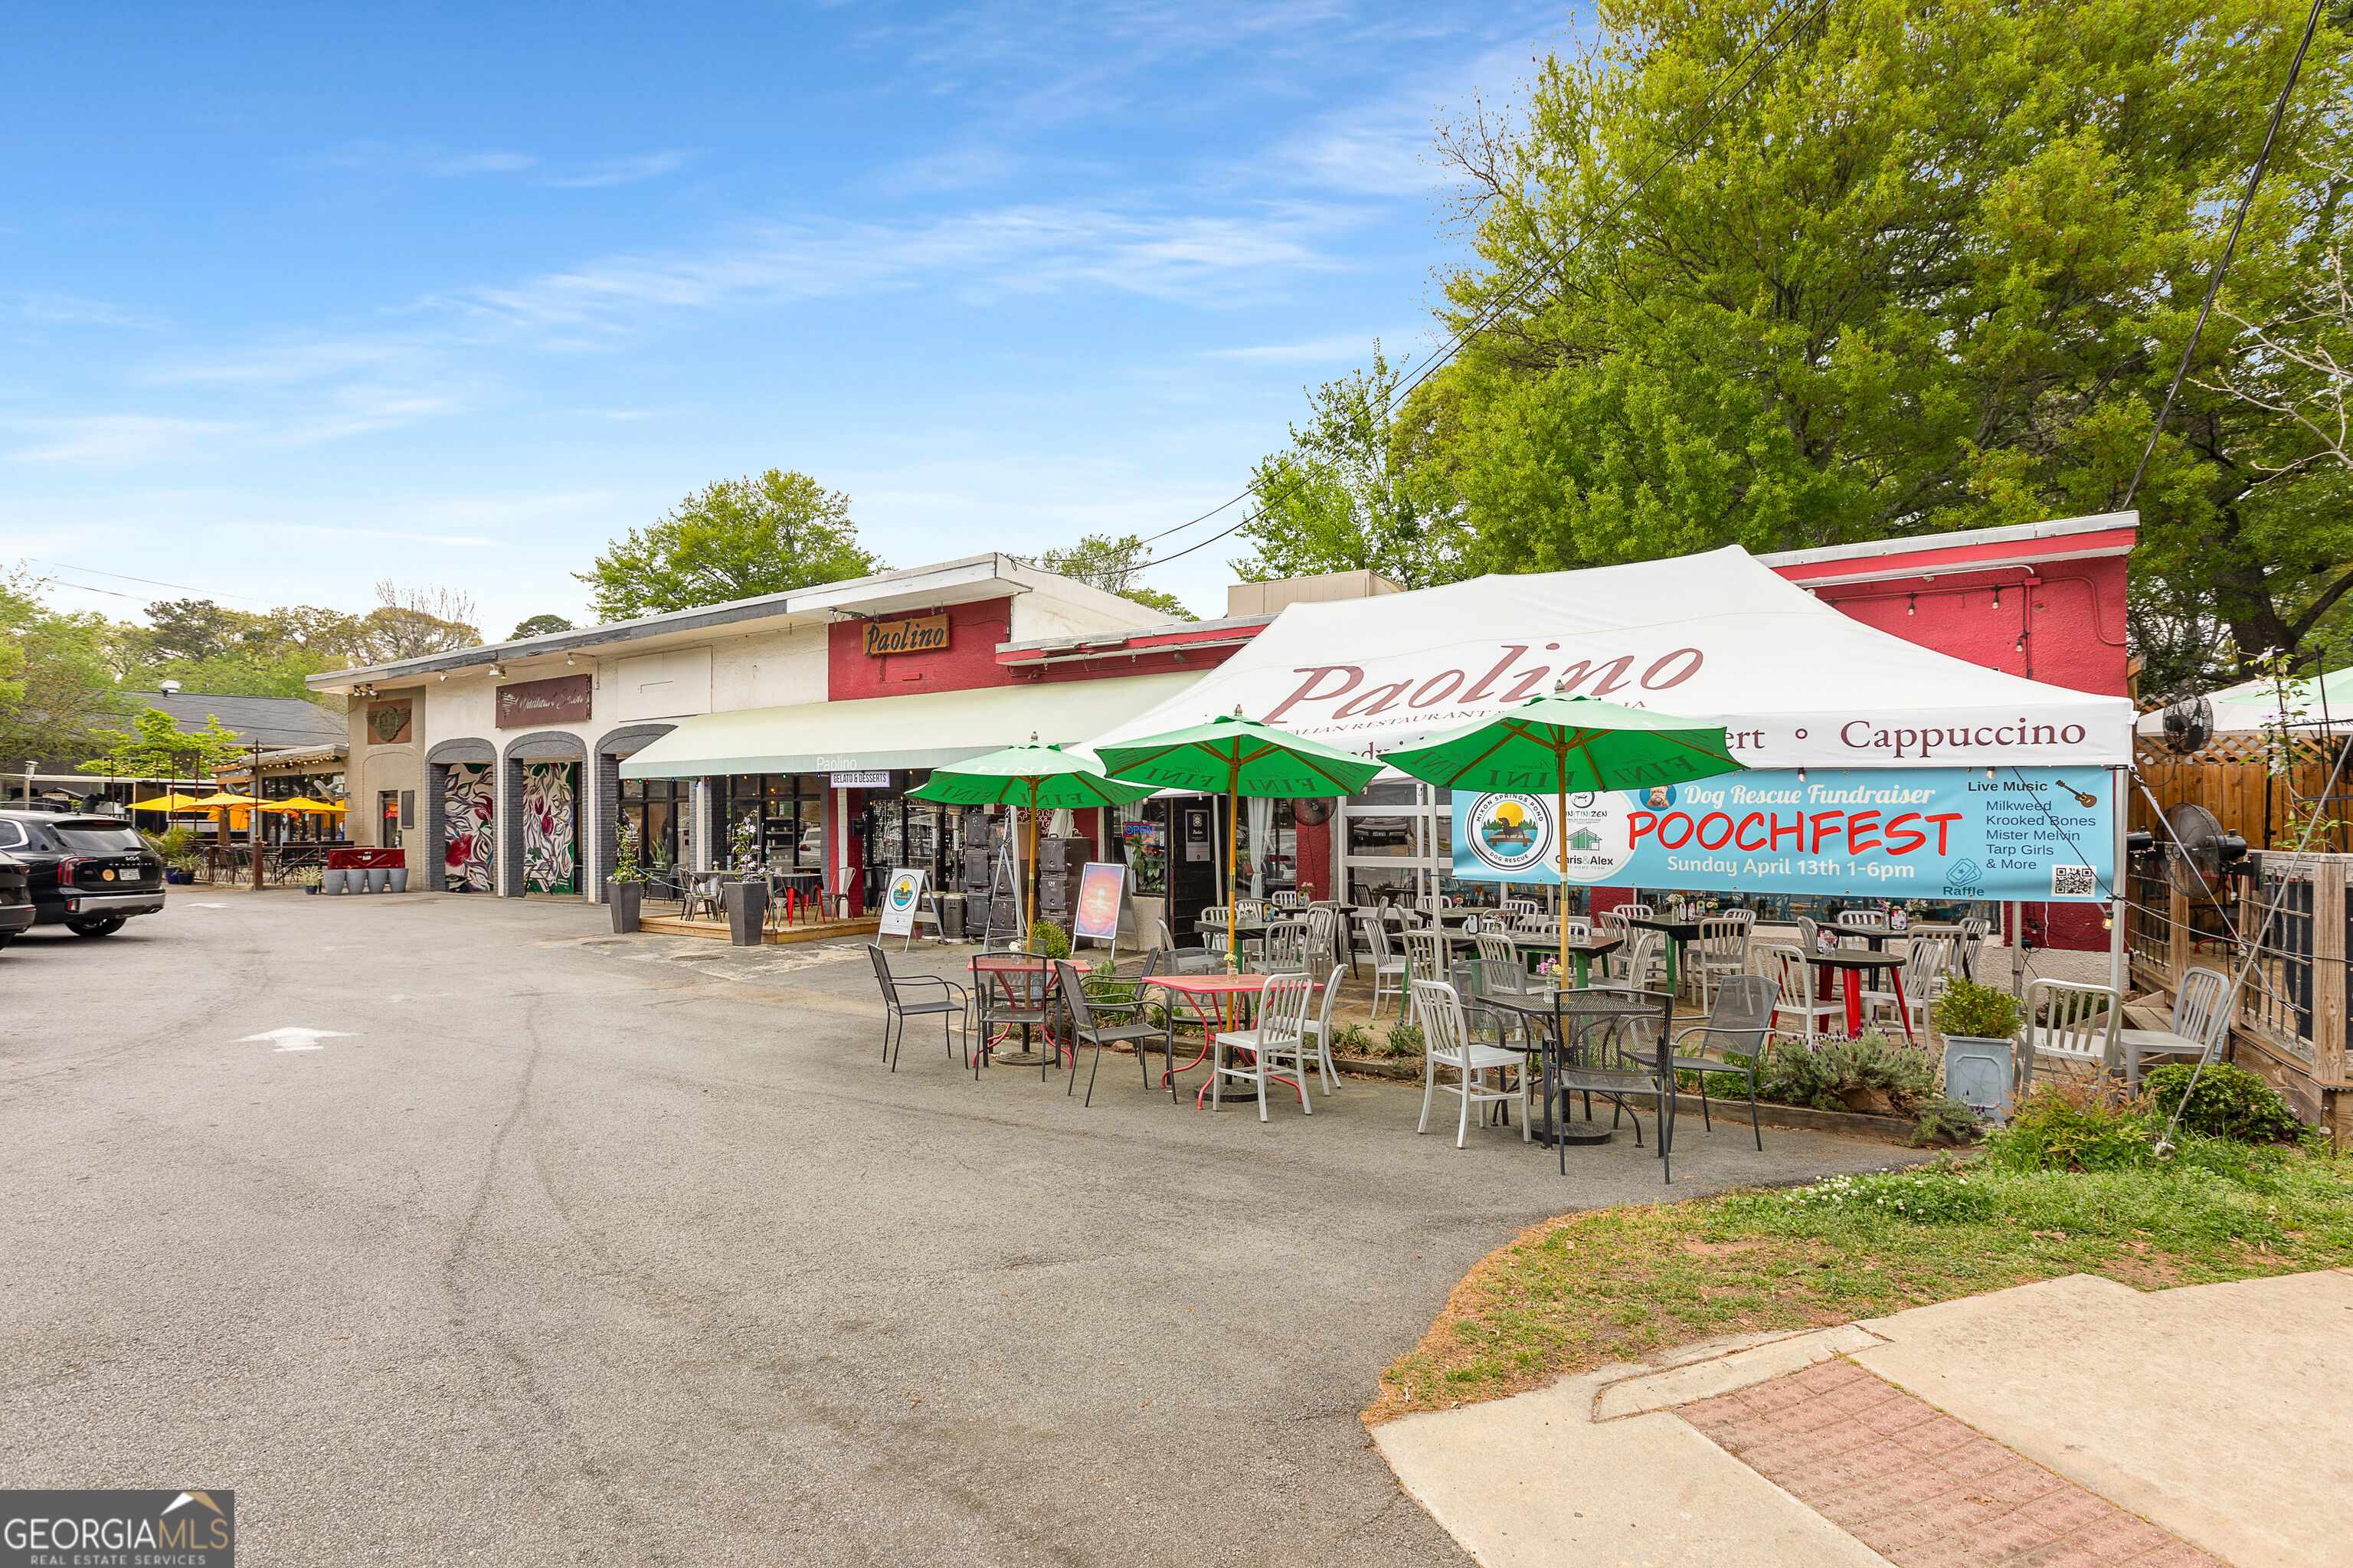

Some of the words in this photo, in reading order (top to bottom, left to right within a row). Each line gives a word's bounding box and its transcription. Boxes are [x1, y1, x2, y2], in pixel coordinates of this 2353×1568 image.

[865, 621, 944, 654] Paolino
[1260, 643, 1703, 724] Paolino
[556, 688, 584, 709] Salon
[1352, 710, 1491, 728] RESTAURANT
[1840, 717, 2086, 759] Cappuccino
[817, 756, 857, 771] Paolino
[833, 774, 853, 783] GELATO
[854, 774, 858, 782] &
[859, 773, 887, 783] DESSERTS
[1968, 782, 1998, 791] Live
[2003, 781, 2048, 791] Music
[1684, 784, 1726, 810] Dog
[1730, 784, 1802, 804] Rescue
[1807, 784, 1936, 804] Fundraiser
[1476, 800, 1493, 822] MIXON
[1494, 794, 1528, 803] SPRINGS
[1530, 801, 1544, 822] POND
[1986, 800, 2052, 811] Milkweed
[1986, 815, 2045, 826] Krooked
[2050, 816, 2096, 827] Bones
[1627, 810, 1963, 856] POOCHFEST
[1986, 830, 2029, 840] Mister
[2034, 830, 2080, 841] Melvin
[1489, 852, 1502, 862] DOG
[1504, 853, 1529, 863] RESCUE
[1986, 844, 2017, 856] Tarp
[2021, 845, 2054, 856] Girls
[1667, 856, 1738, 876] Sunday
[1743, 857, 1792, 877] April
[1797, 859, 1841, 876] 13th
[1847, 859, 1914, 882] 1-6pm
[1986, 859, 1997, 869] &
[2001, 859, 2037, 870] More
[1942, 886, 1985, 896] Raffle
